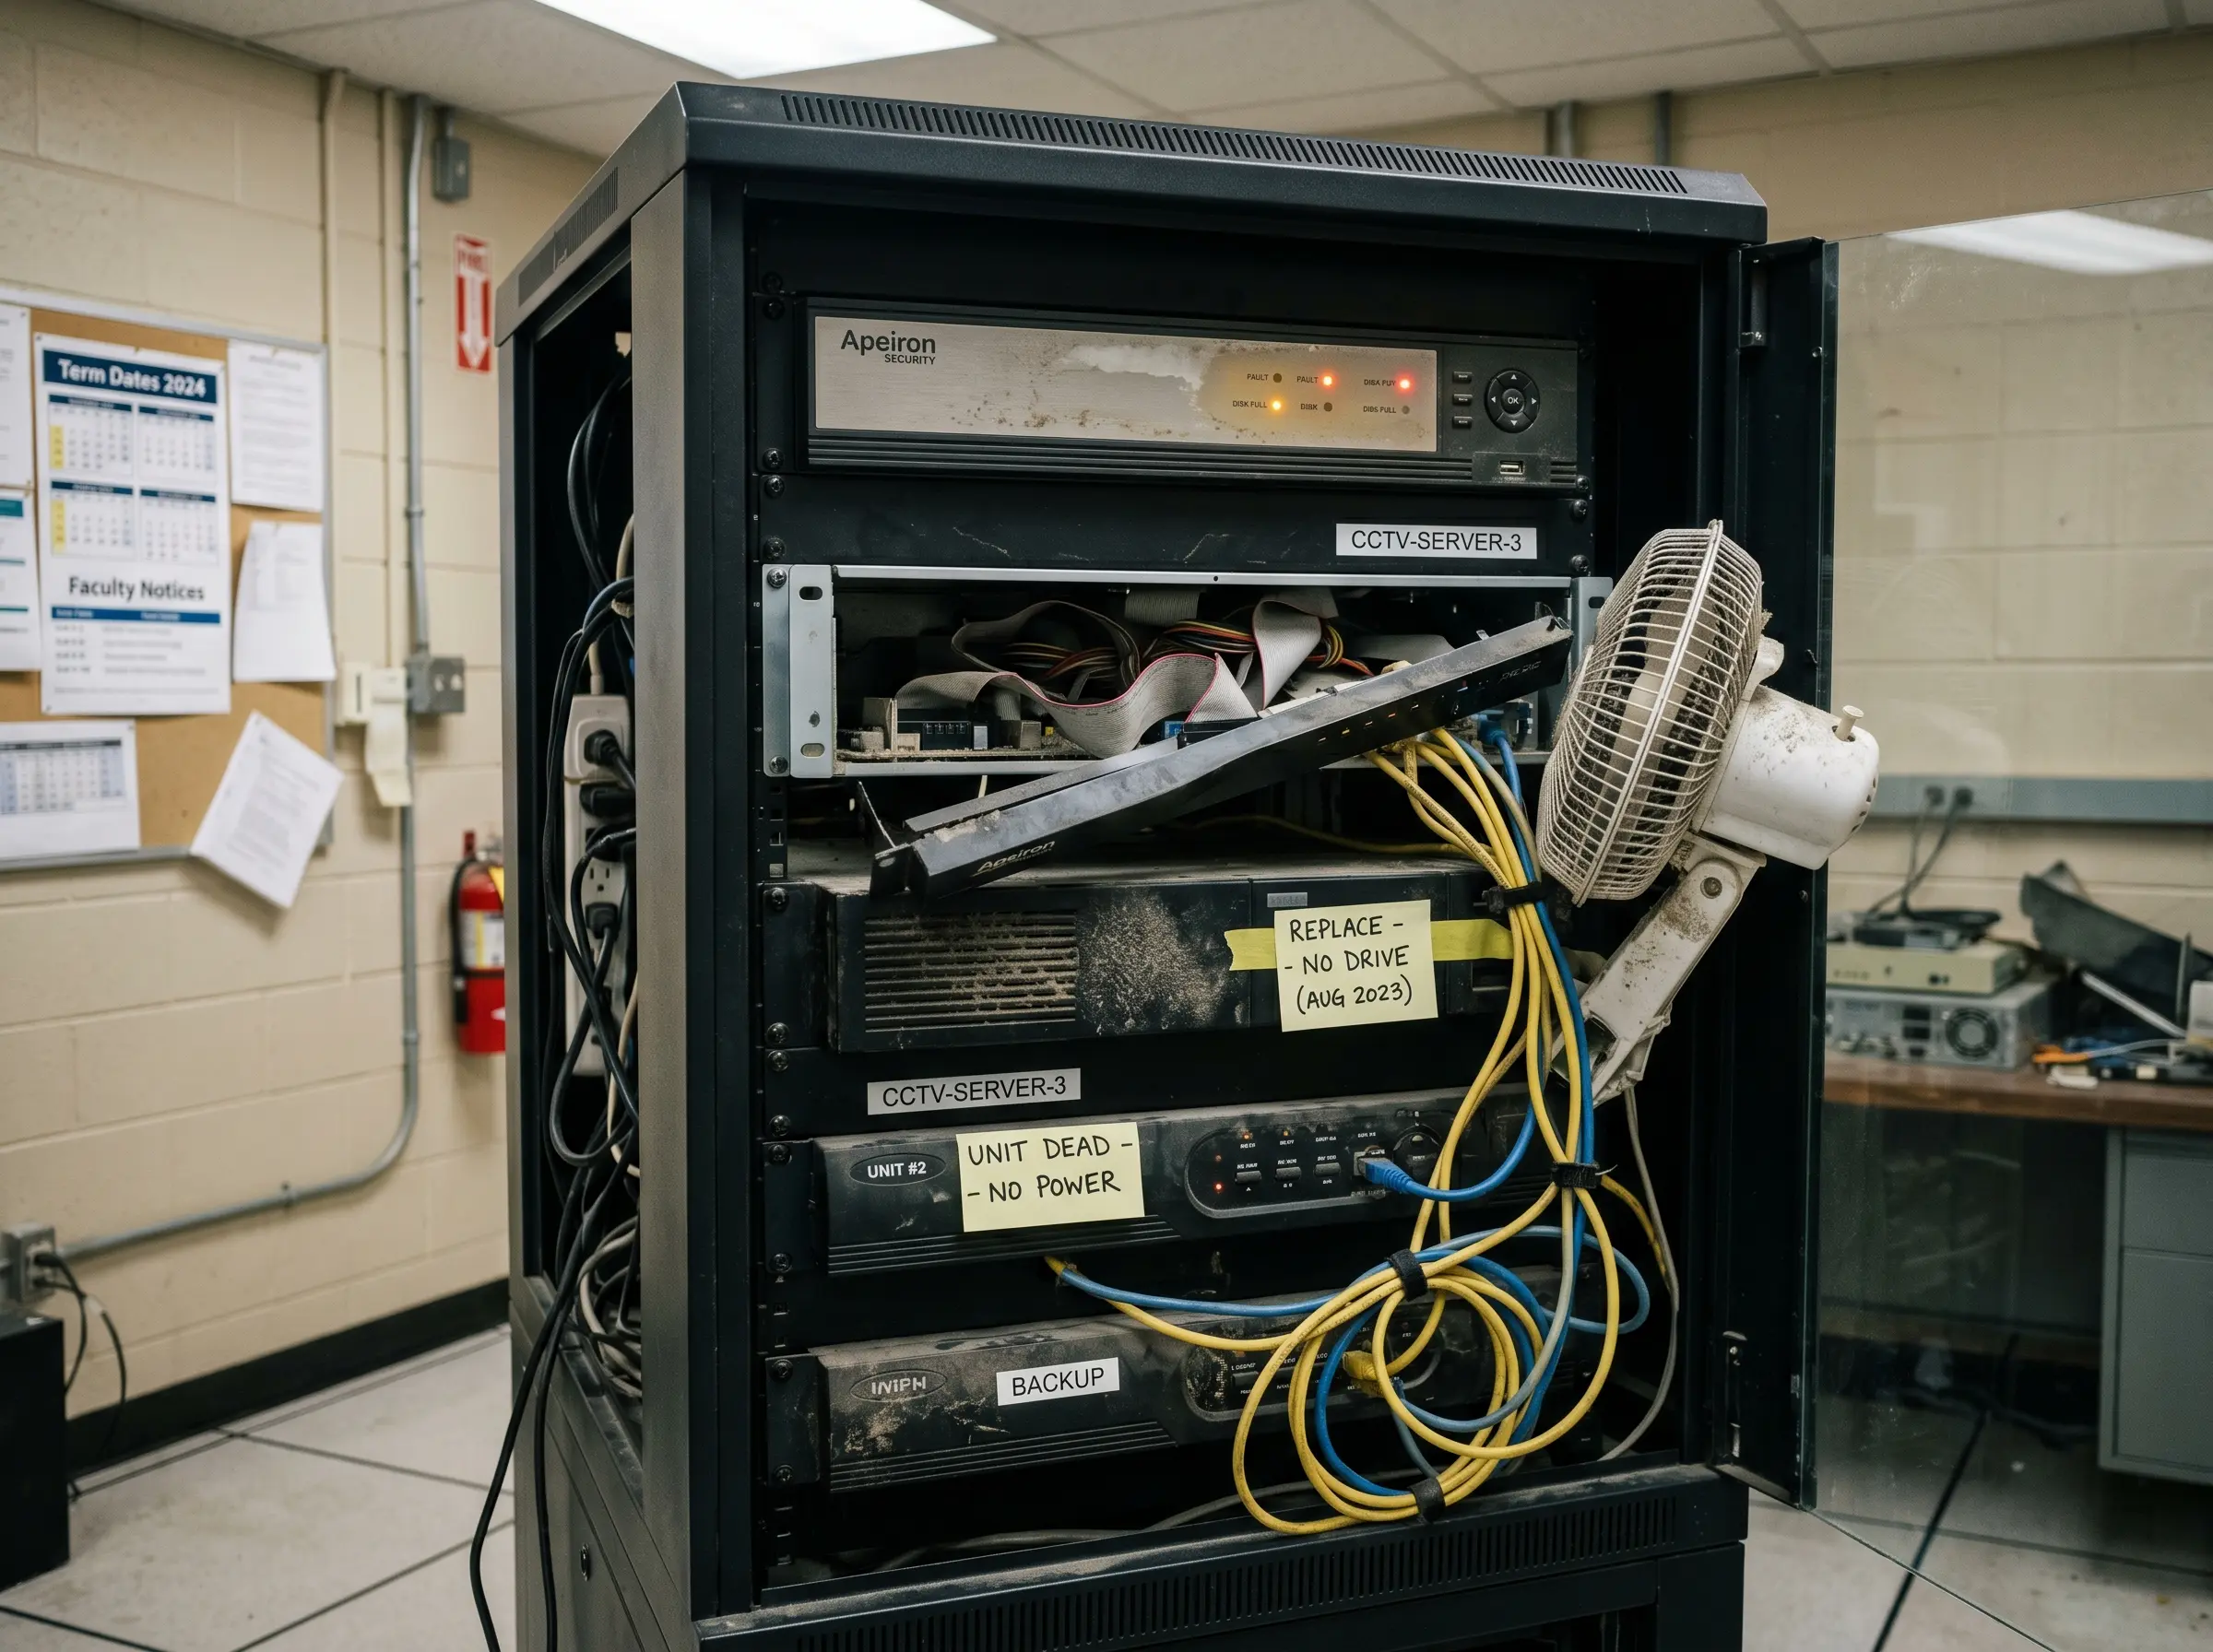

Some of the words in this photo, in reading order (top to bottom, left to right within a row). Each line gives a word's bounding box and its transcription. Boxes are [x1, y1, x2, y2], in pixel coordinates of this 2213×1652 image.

[840, 329, 936, 356] Apeiron
[884, 353, 936, 365] SECURITY
[57, 358, 106, 385] Term
[110, 366, 160, 392] Dates
[163, 372, 207, 399] 2024
[1508, 396, 1520, 405] OK
[1351, 530, 1522, 552] CCTV-SERVER-3
[69, 575, 136, 600] Faculty
[140, 582, 206, 600] Notices
[1290, 915, 1383, 942] REPLACE
[1303, 953, 1333, 975] NO
[1343, 944, 1410, 972] DRIVE
[1296, 985, 1345, 1016] (AUG
[1353, 974, 1413, 1007] 2023)
[882, 1076, 1066, 1107] CCTV-SERVER-3
[967, 1139, 1028, 1166] UNIT
[1042, 1135, 1110, 1160] DEAD
[867, 1162, 905, 1179] UNIT
[907, 1161, 927, 1175] #2
[988, 1181, 1023, 1203] NO
[1035, 1170, 1121, 1198] POWER
[1012, 1367, 1105, 1397] BACKUP
